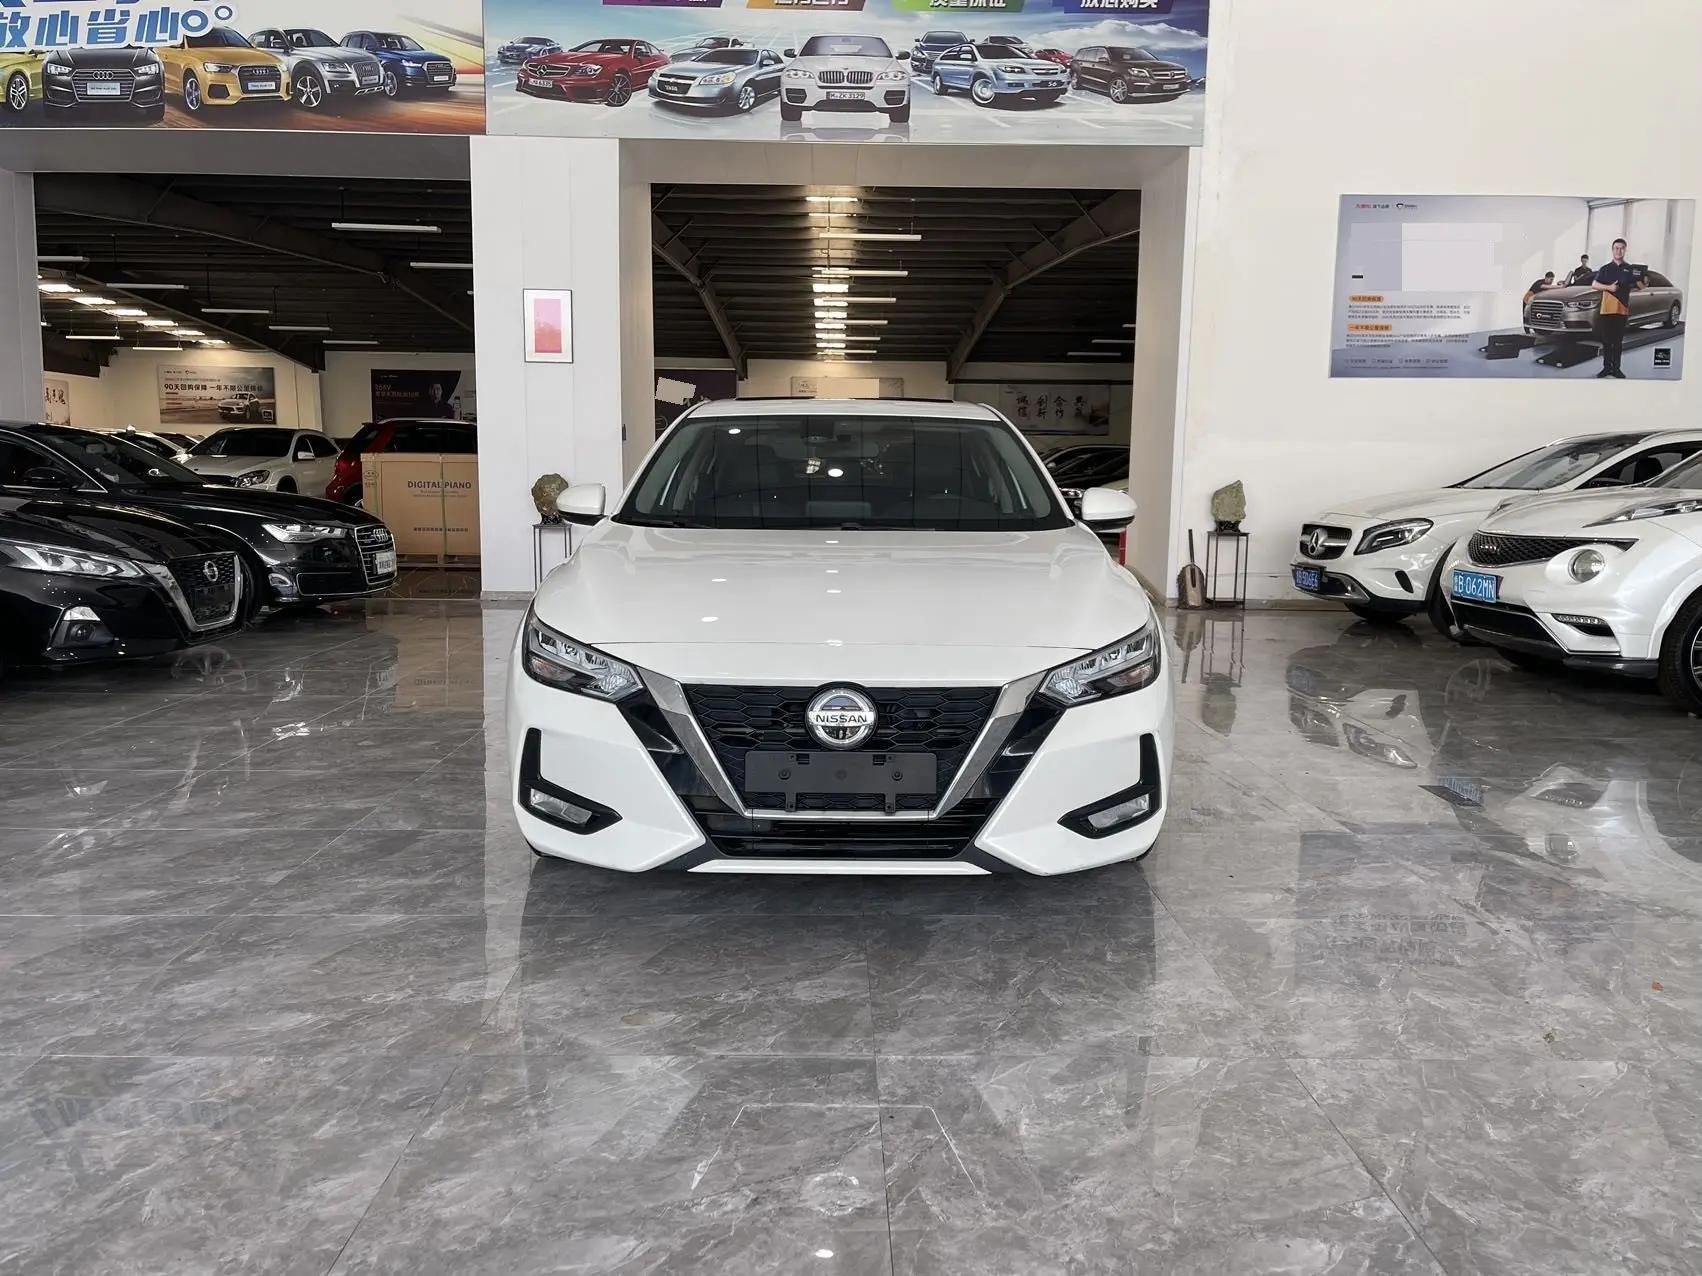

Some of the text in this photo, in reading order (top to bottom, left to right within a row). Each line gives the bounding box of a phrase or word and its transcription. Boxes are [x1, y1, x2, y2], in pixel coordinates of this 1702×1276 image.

[407, 480, 472, 489] DIGITAL PIANO
[815, 714, 867, 723] NISSAN
